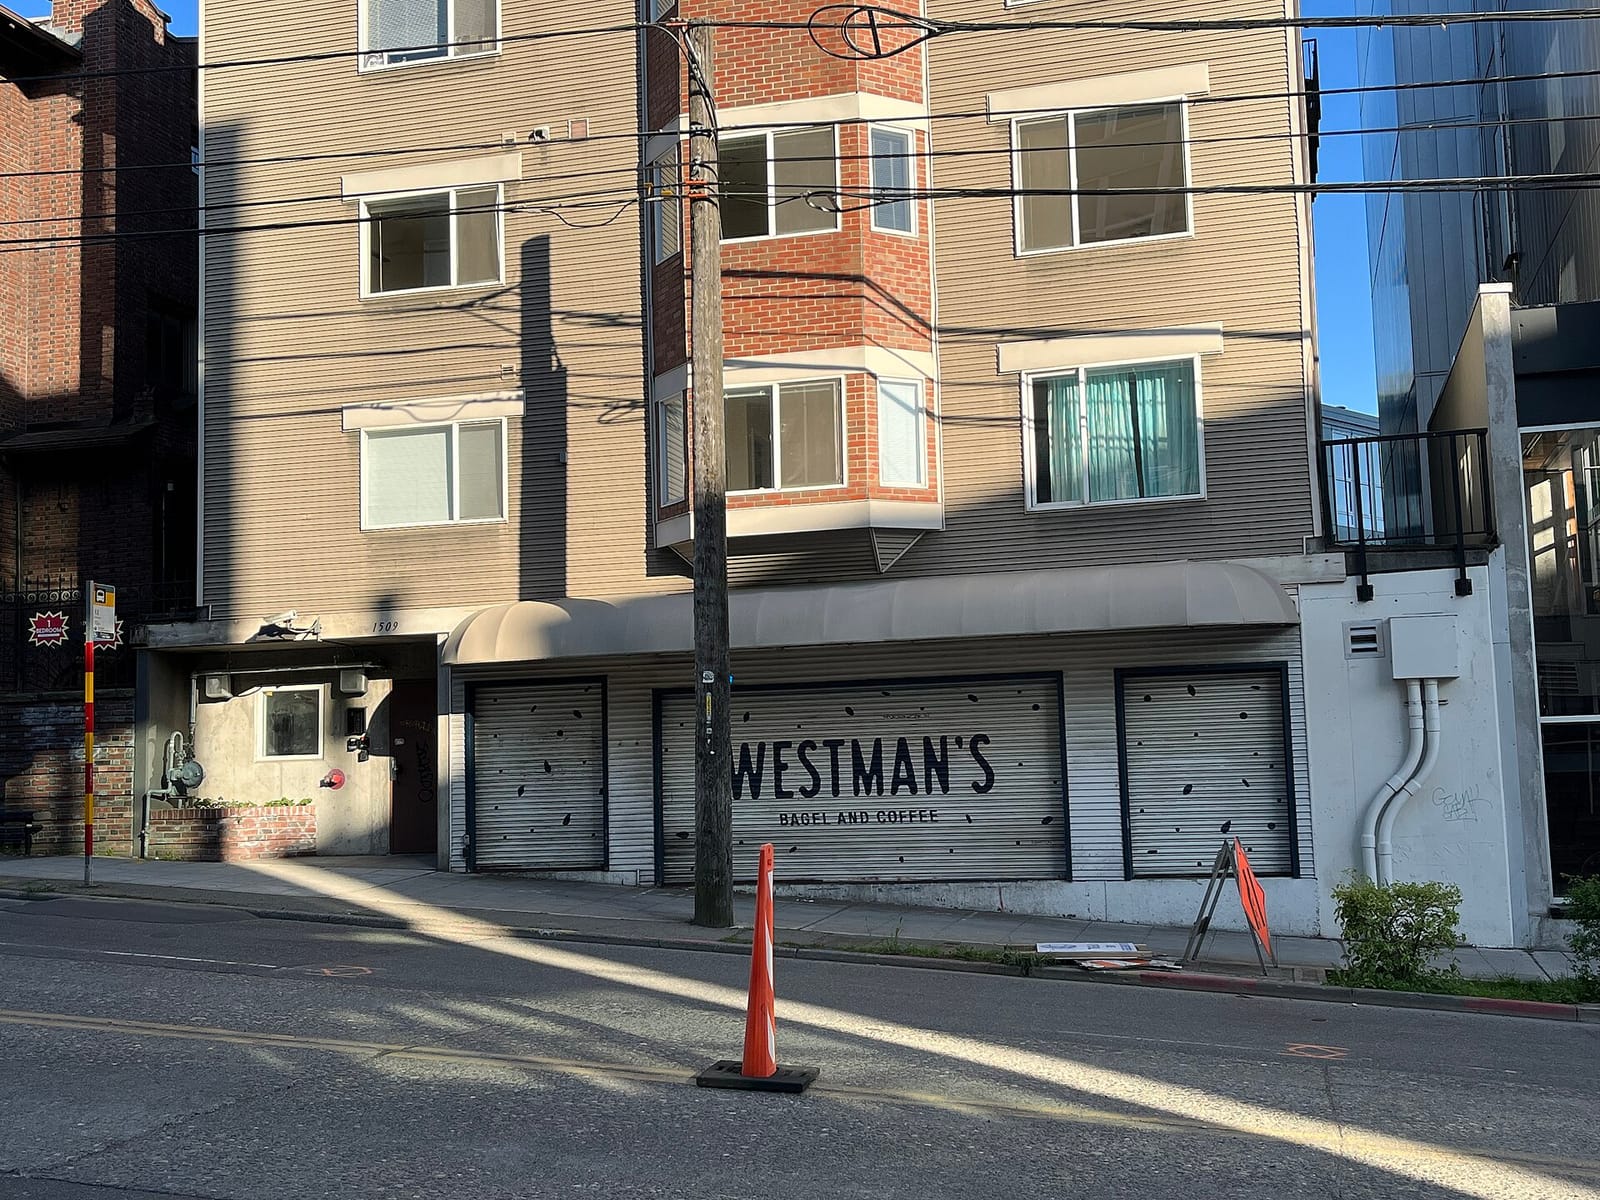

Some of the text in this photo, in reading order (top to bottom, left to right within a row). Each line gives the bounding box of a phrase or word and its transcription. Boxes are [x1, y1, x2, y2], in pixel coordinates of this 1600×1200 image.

[372, 621, 399, 633] 1509
[731, 733, 995, 800] WESTMAN'S
[779, 809, 939, 827] BAGEL AND COFFEE
